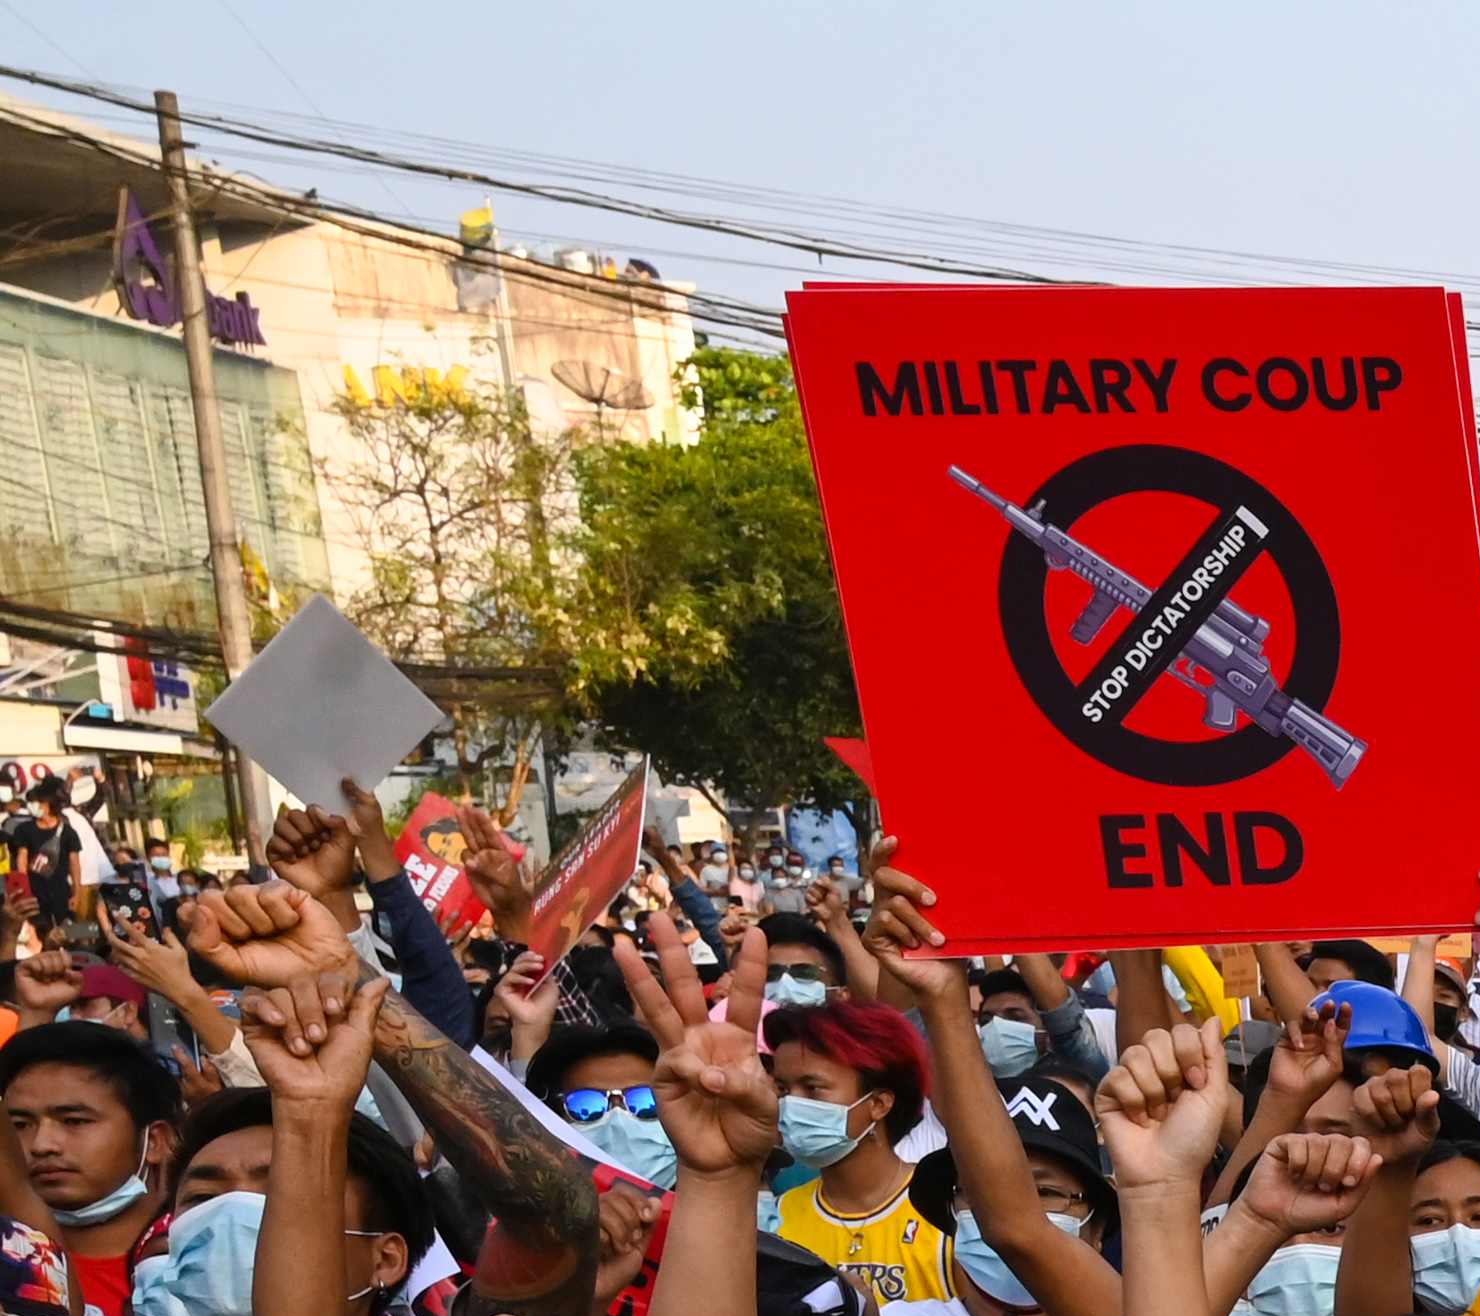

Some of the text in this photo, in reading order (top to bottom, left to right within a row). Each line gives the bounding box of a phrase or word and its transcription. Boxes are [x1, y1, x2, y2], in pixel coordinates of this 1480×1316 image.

[855, 355, 1403, 417] MILITARY COUP
[1081, 524, 1249, 724] STOP DICTATORSHIP
[1098, 810, 1305, 890] END
